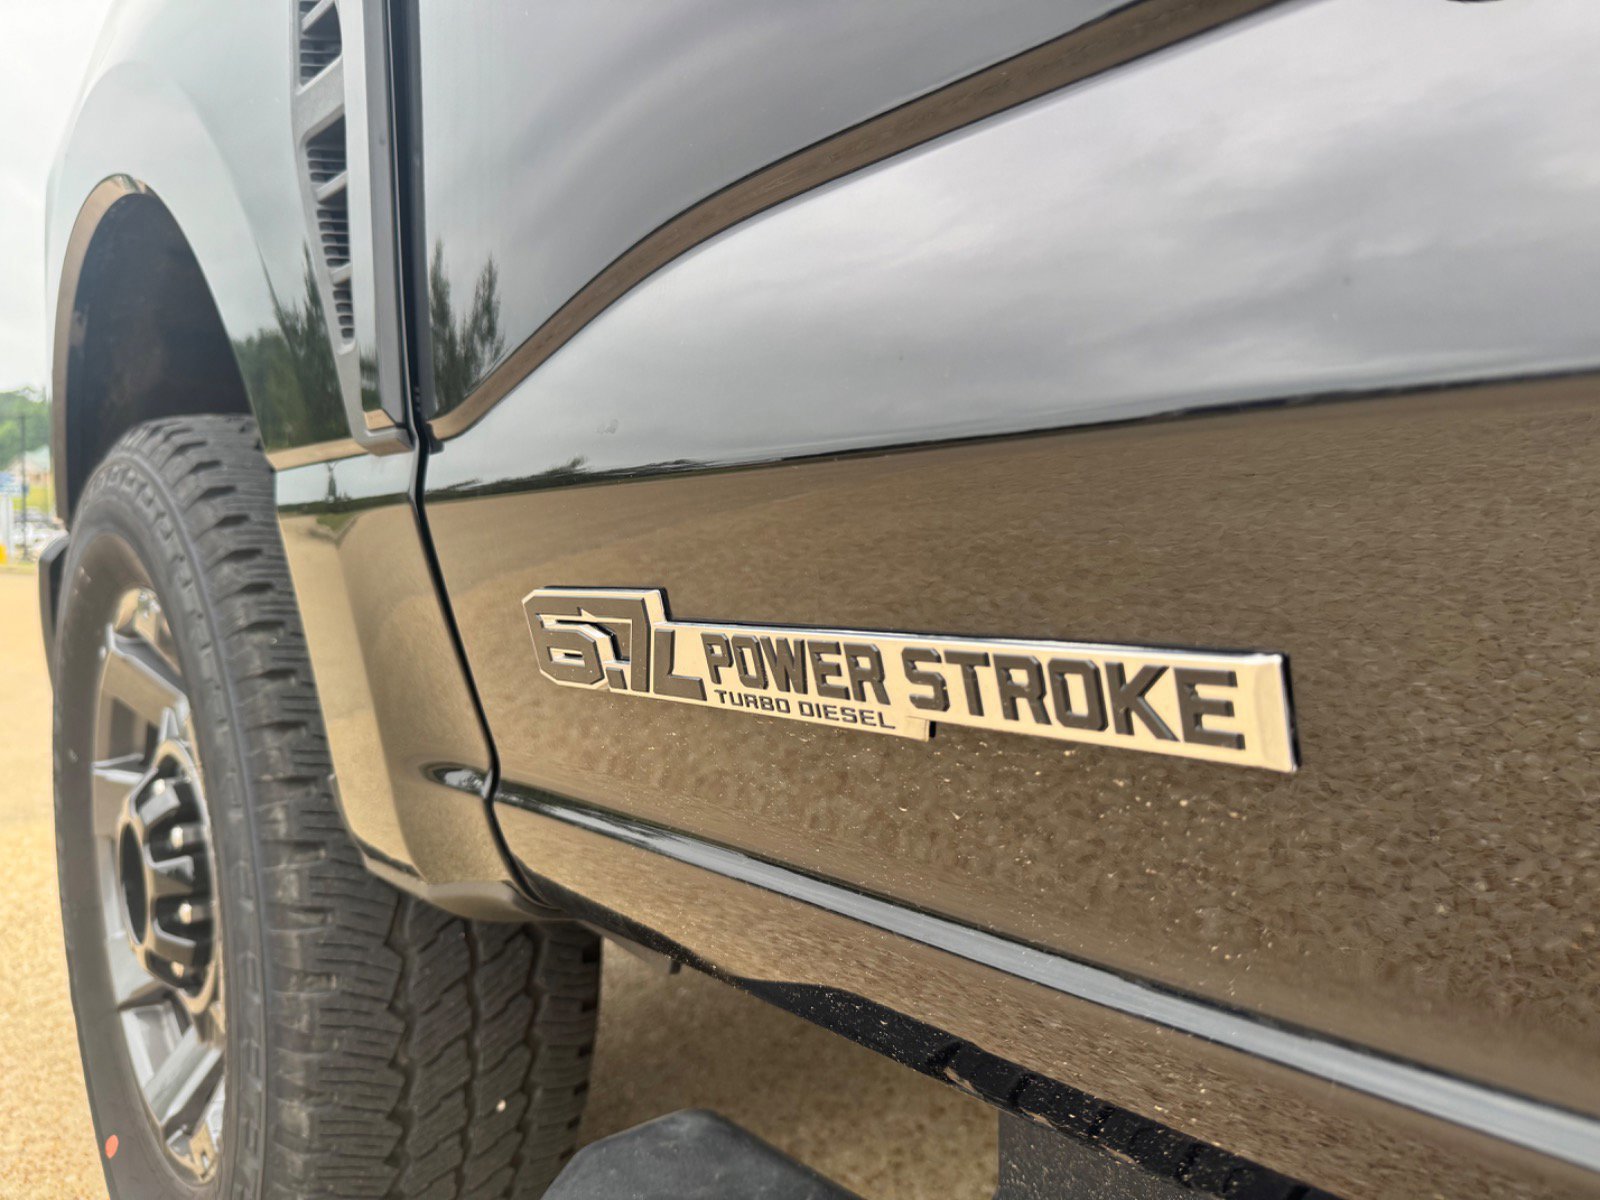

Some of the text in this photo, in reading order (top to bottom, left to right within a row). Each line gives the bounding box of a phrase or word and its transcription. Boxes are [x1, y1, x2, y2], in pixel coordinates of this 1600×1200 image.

[700, 632, 891, 706] POWER
[901, 646, 1246, 751] STROKE
[713, 688, 897, 730] TURBO DIESEL
